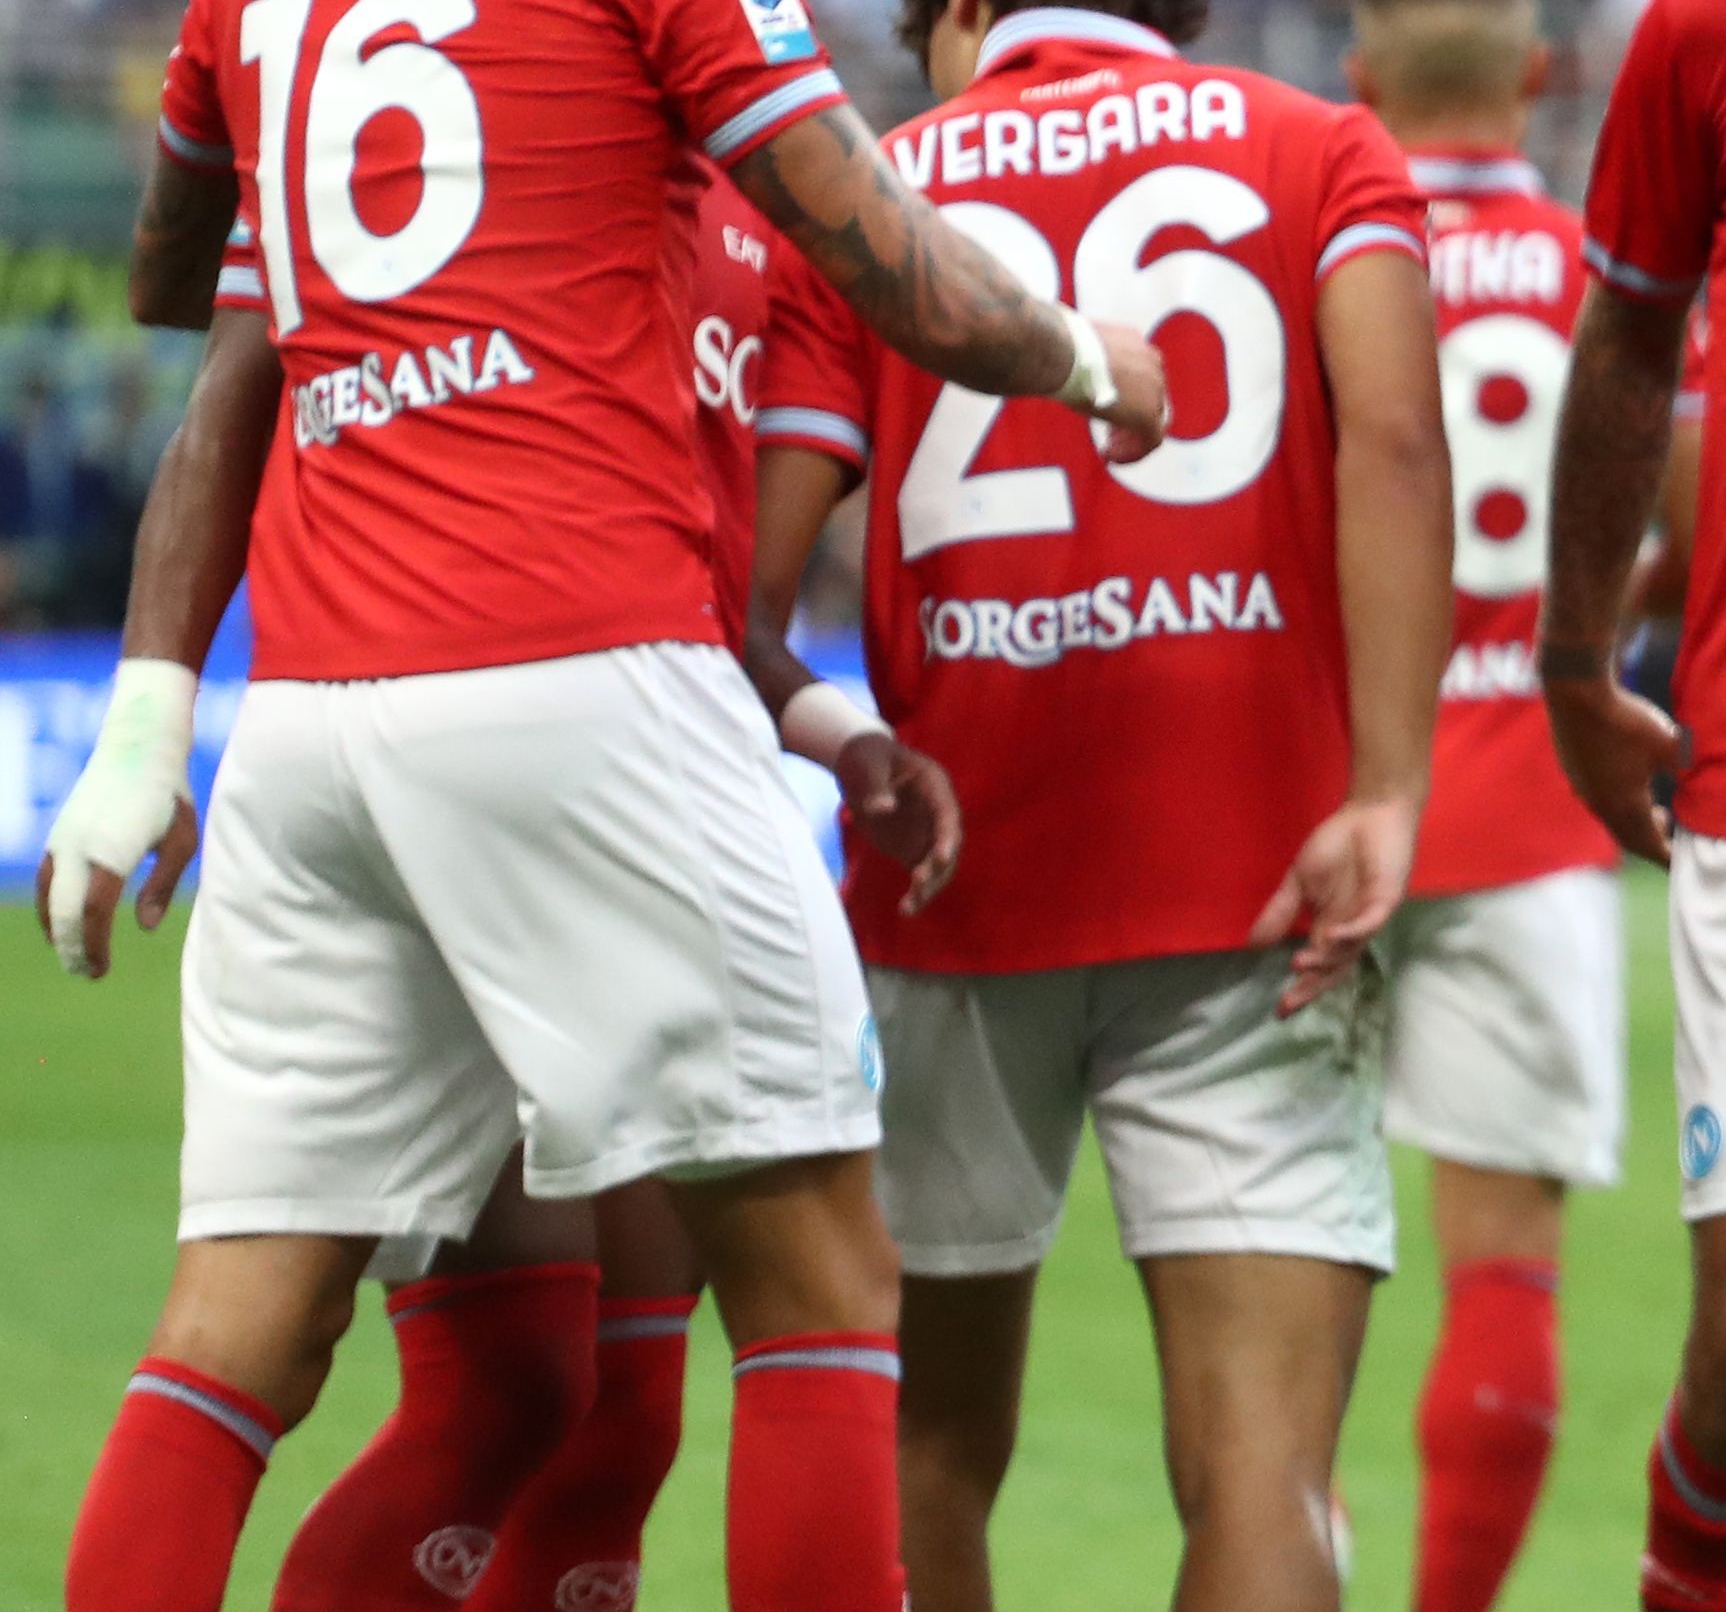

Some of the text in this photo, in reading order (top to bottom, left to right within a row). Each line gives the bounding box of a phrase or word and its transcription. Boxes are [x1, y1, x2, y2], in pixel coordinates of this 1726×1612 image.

[893, 79, 1247, 191] VERGARA
[693, 315, 764, 425] SC
[899, 165, 1286, 560] 26
